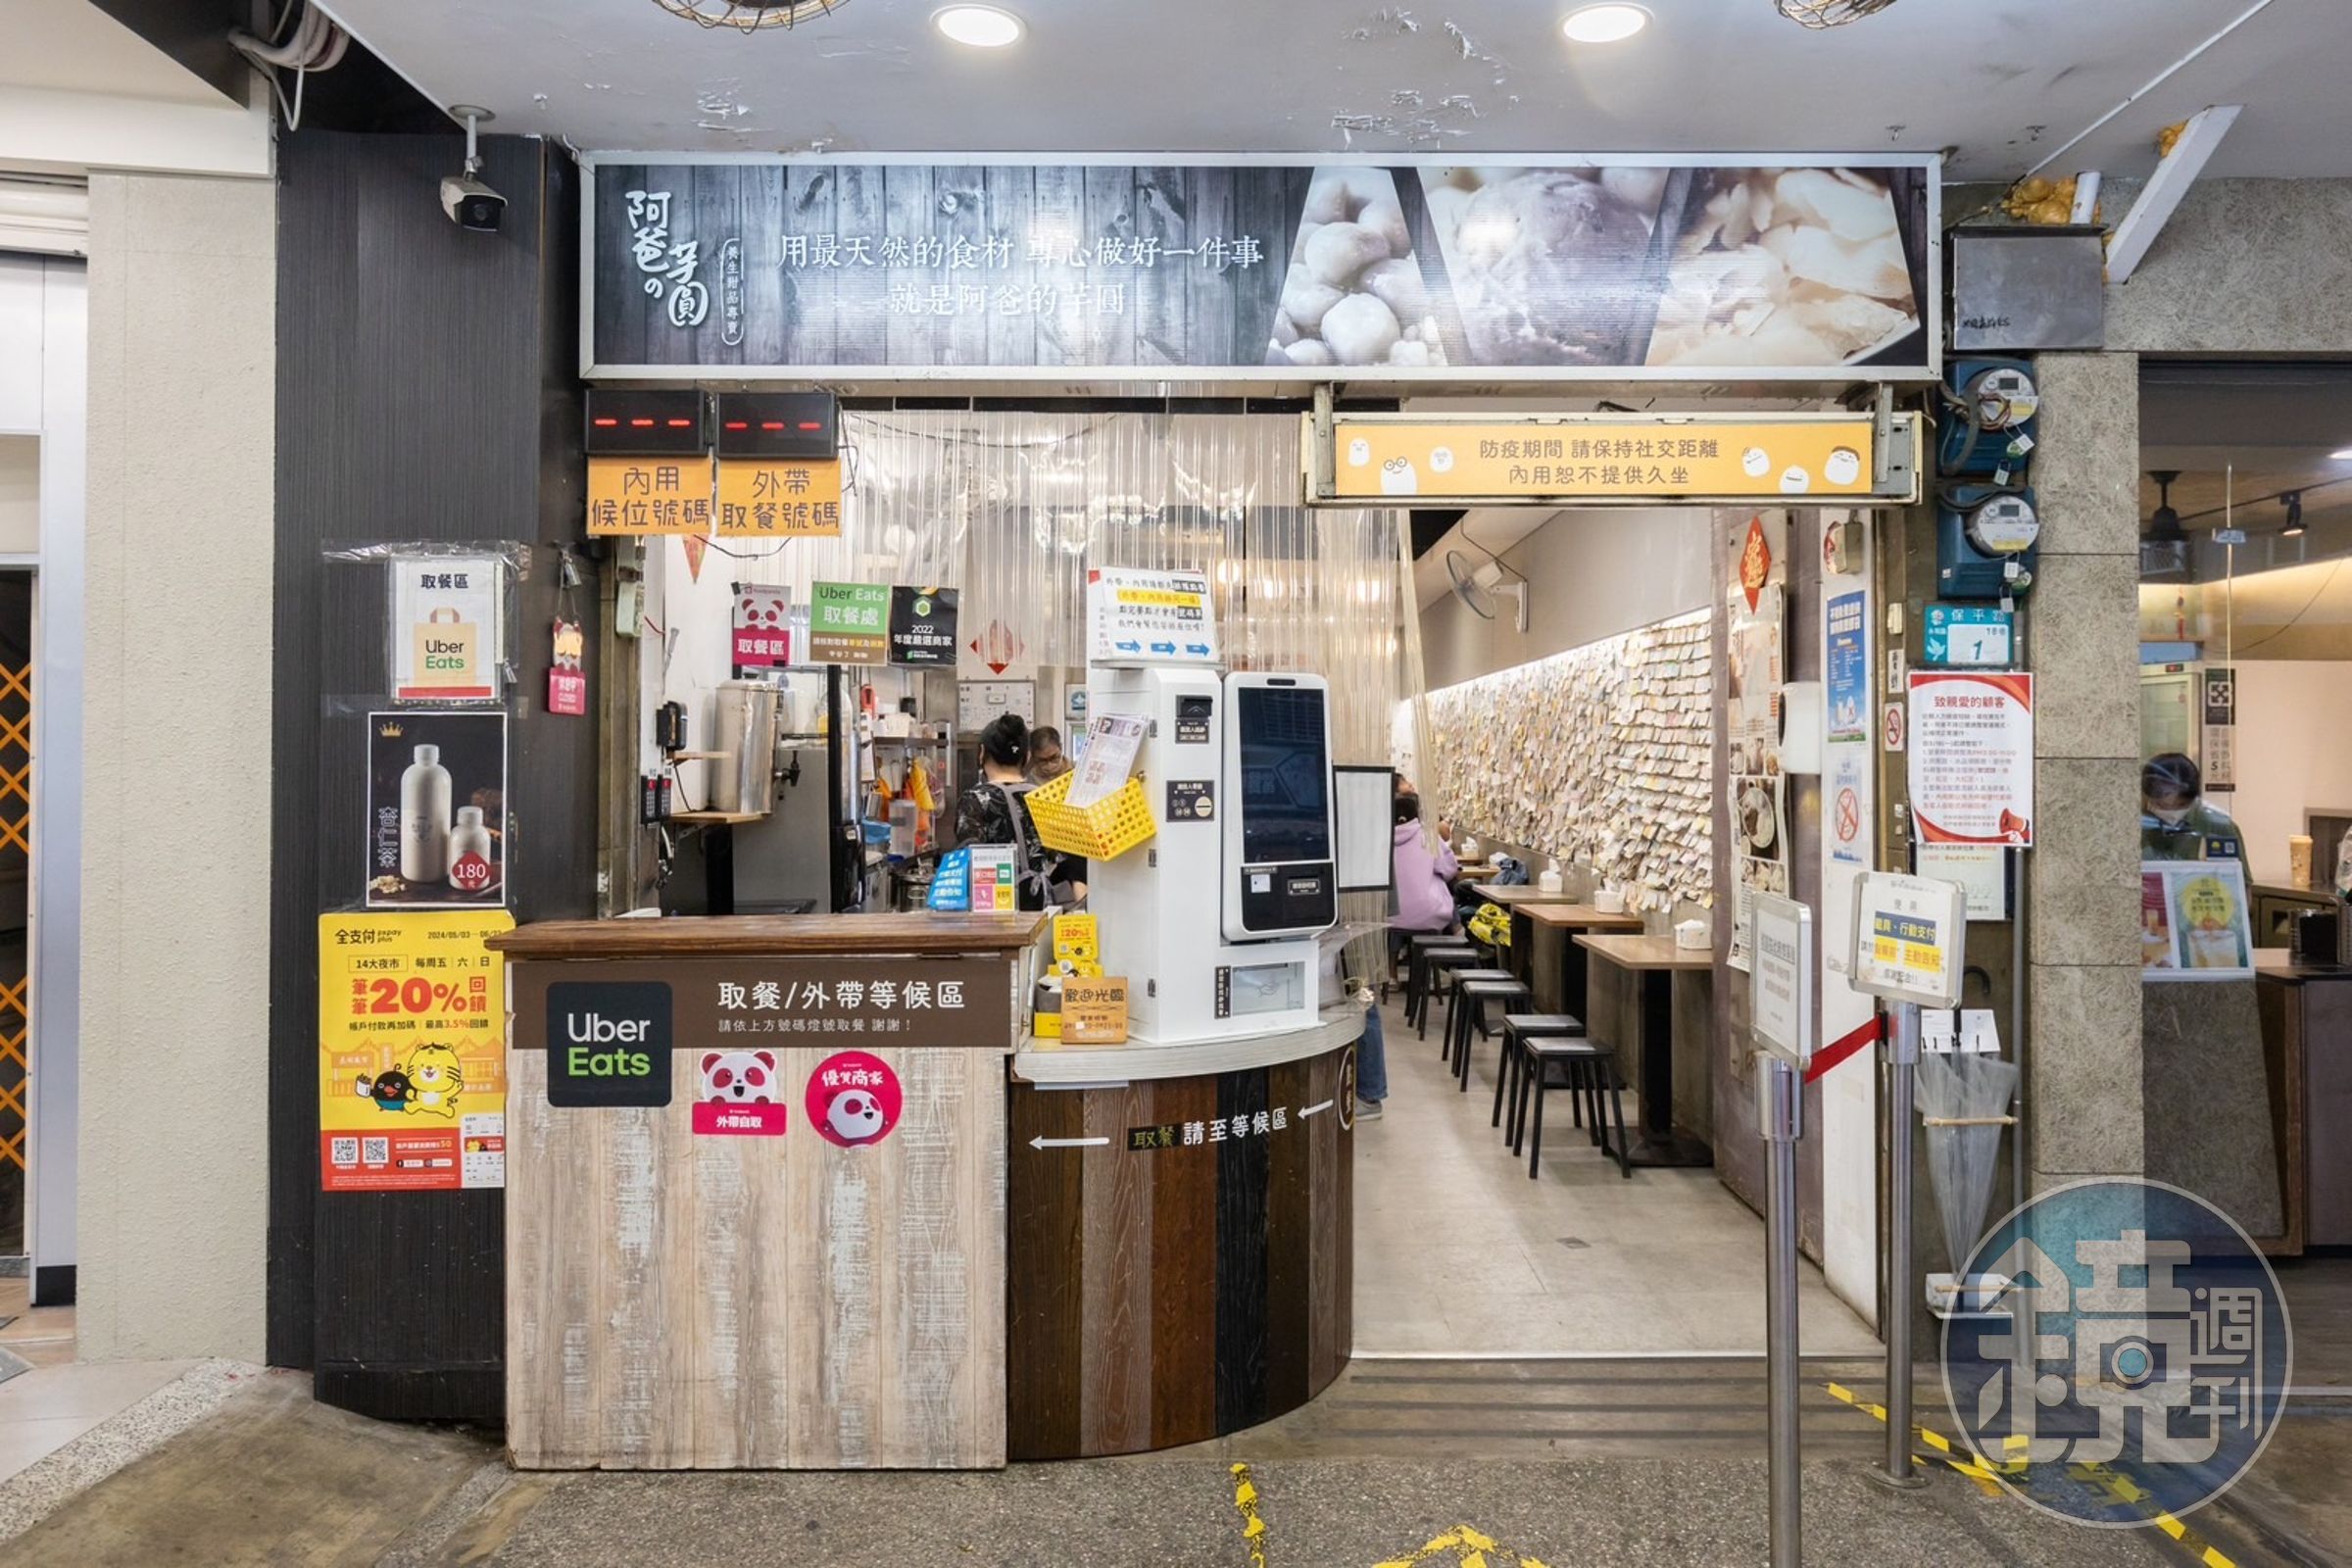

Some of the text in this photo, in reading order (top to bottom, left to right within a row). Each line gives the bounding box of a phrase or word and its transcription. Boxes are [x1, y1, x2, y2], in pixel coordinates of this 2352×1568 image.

[779, 234, 1265, 269] 用最天然的食材 專心做好一件事
[666, 240, 710, 326] 芋圓
[889, 282, 1125, 316] 就是阿爸的芋圓
[1480, 438, 1721, 460] 防疫期間 請保持社交距離
[623, 466, 679, 496] 內用
[753, 468, 810, 498] 外帶
[1509, 465, 1690, 485] 內用恕不提供久坐
[592, 499, 710, 526] 候位號碼
[721, 501, 839, 529] 取餐號碼
[420, 573, 469, 589] 取餐區
[819, 587, 885, 602] Uber Eats
[823, 606, 879, 626] 取餐處
[1952, 609, 2005, 622] 保平路
[911, 625, 934, 634] 2022
[425, 640, 465, 654] Uber
[738, 638, 785, 655] 取餐區
[1973, 640, 1983, 661] 1
[425, 656, 465, 669] Eats
[1934, 695, 2005, 709] 致親愛的顧客
[457, 863, 486, 879] 180
[335, 929, 375, 945] 全支付
[356, 958, 400, 969] 14大夜市
[458, 956, 468, 967] 六
[480, 956, 490, 966] 日
[369, 977, 467, 1014] 20%
[469, 976, 487, 1012] 回饋
[717, 980, 966, 1010] 取餐/外帶等候區
[1064, 987, 1125, 1003] 歡迎光臨
[567, 1013, 651, 1042] Uber
[717, 1019, 866, 1033] 請依上方號碼燈號取餐
[567, 1047, 651, 1077] Eats
[716, 1116, 762, 1129] 外帶自取
[1134, 1106, 1289, 1148] 取餐 請至等候區
